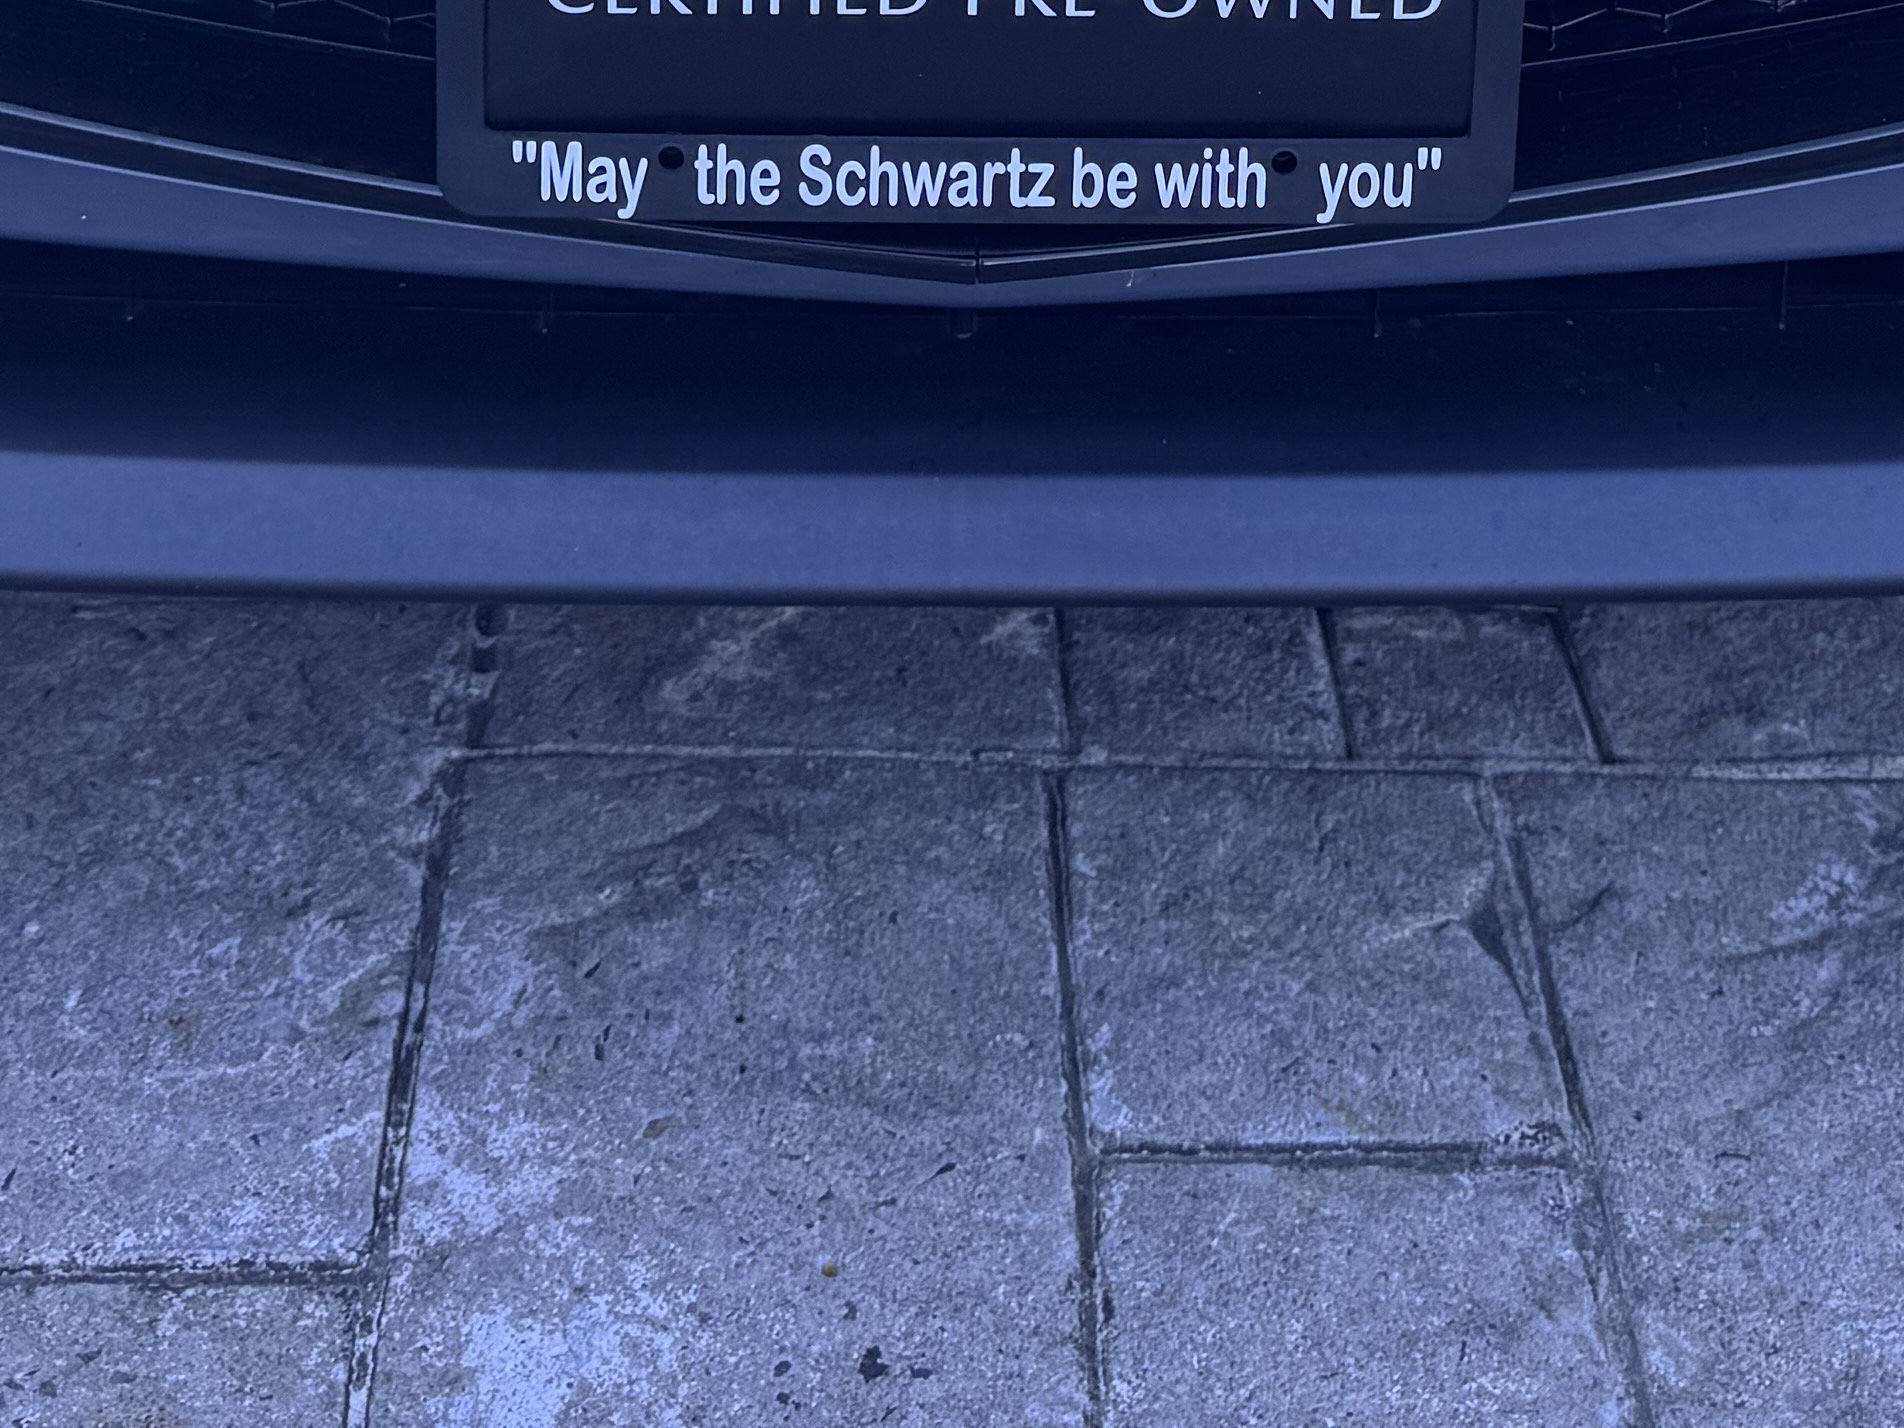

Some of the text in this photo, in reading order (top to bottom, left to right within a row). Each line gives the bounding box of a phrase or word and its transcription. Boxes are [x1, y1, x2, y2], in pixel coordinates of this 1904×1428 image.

[512, 139, 1442, 223] "May the Schwartz be with you"
